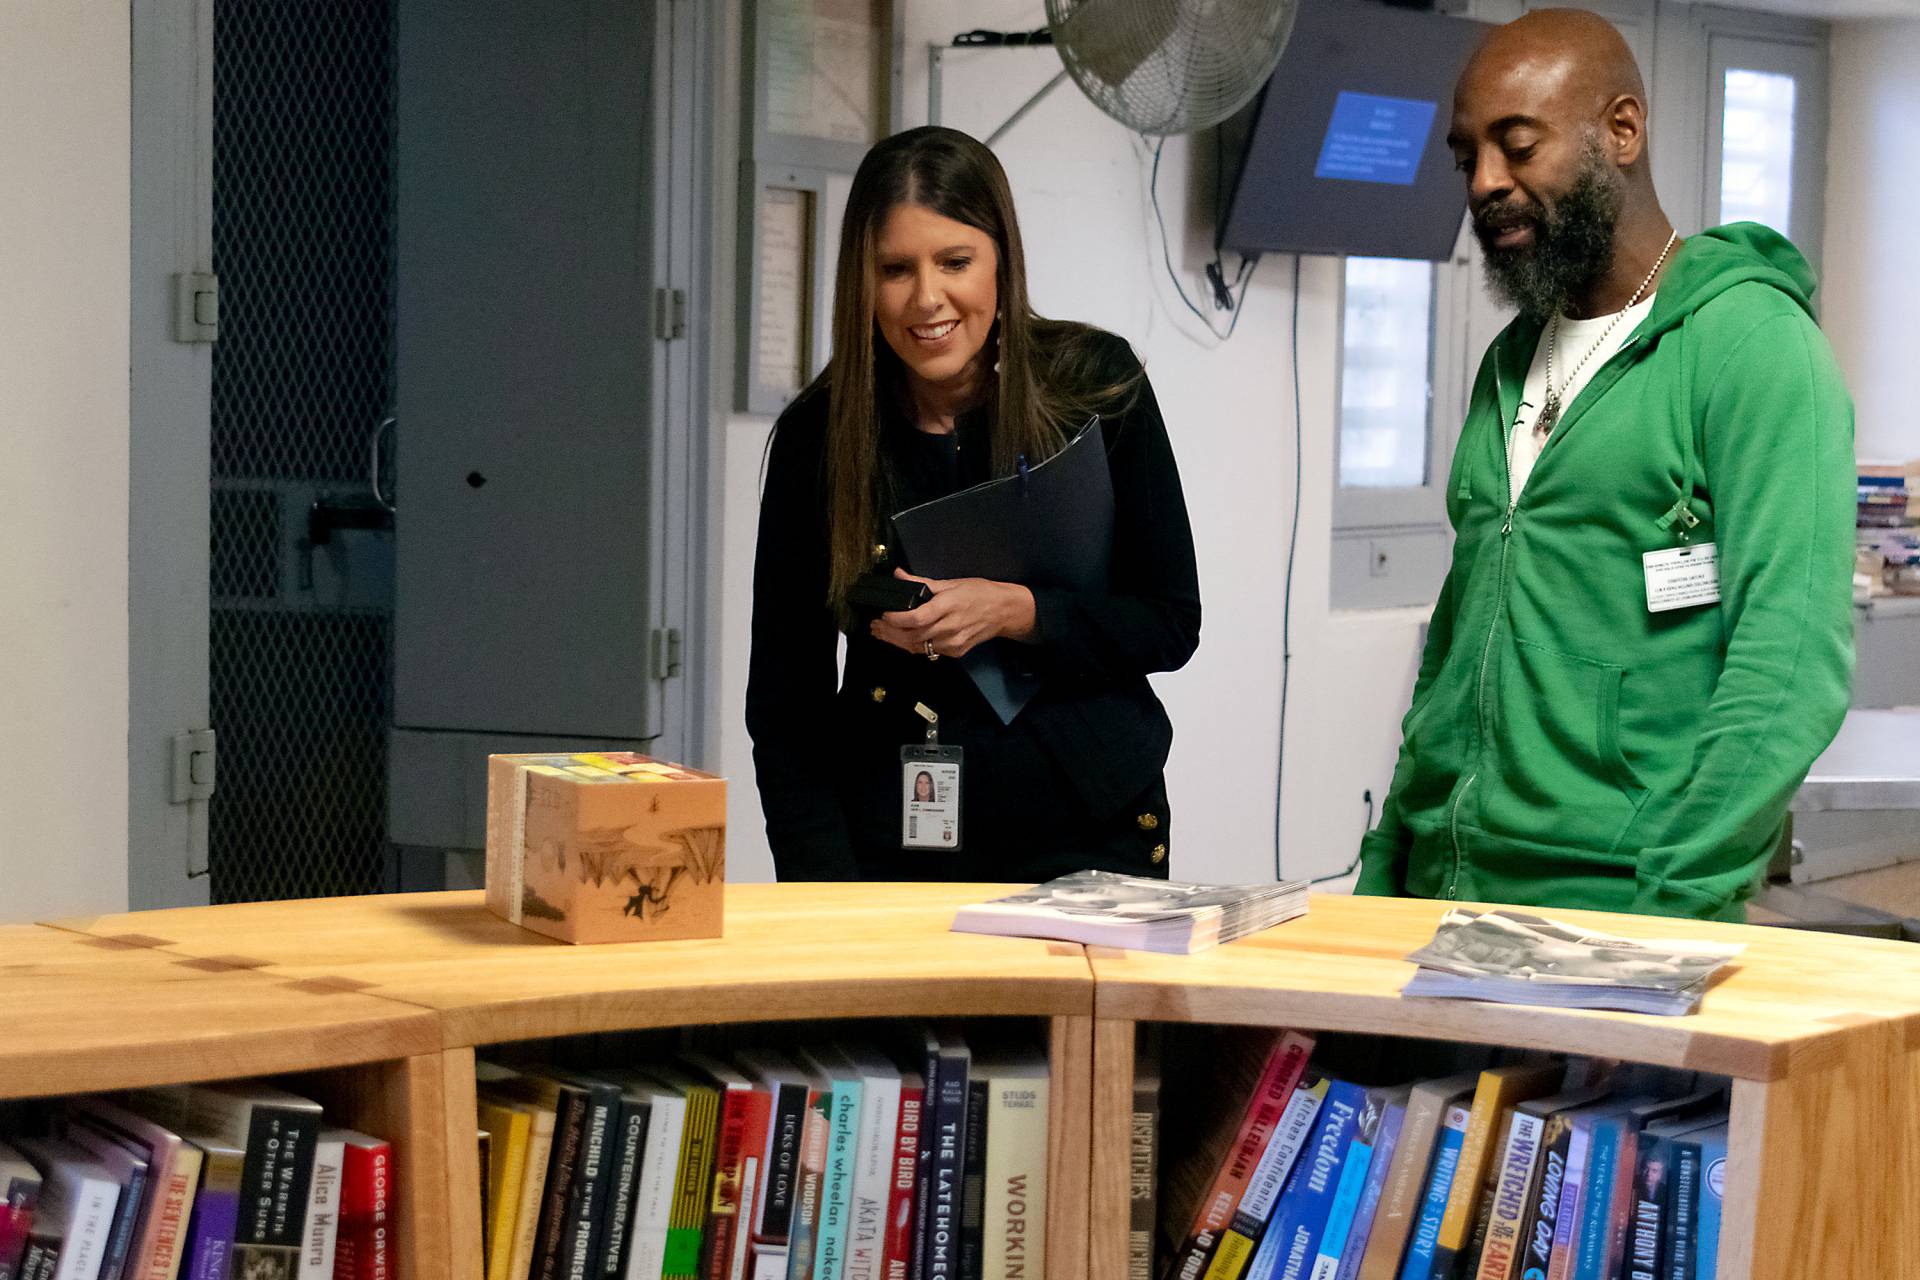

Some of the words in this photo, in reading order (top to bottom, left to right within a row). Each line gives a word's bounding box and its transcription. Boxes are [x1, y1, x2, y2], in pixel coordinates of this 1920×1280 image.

[902, 1100, 921, 1131] BIRD
[1002, 1090, 1036, 1099] STUDS
[781, 1113, 796, 1149] LICKS
[836, 1095, 855, 1152] charles
[1287, 1096, 1316, 1141] Kitchen
[1517, 1119, 1534, 1138] THE
[284, 1129, 300, 1159] THE
[585, 1106, 608, 1177] MANCHILD
[780, 1151, 791, 1166] OF
[900, 1137, 917, 1152] BY
[940, 1122, 956, 1159] THE
[1132, 1112, 1153, 1199] DISPATCHES
[1231, 1102, 1271, 1180] HALLELUJAH
[1308, 1100, 1354, 1193] Freedom
[169, 1174, 189, 1195] THE
[262, 1139, 280, 1190] OTHER
[315, 1164, 337, 1205] Alice
[897, 1157, 914, 1188] BIRD
[1252, 1145, 1294, 1217] Confidential
[1428, 1147, 1458, 1204] WRITING
[1497, 1139, 1535, 1220] WRETCHED
[1540, 1151, 1563, 1218] LOVING
[274, 1167, 294, 1234] WARMTH
[375, 1154, 386, 1222] GEORGE
[583, 1195, 592, 1216] THE
[586, 1182, 593, 1193] IN
[607, 1114, 641, 1273] COUNTERNARRATIVES
[774, 1173, 789, 1208] LOVE
[801, 1173, 817, 1225] WOODSON
[827, 1157, 848, 1226] wheelan
[1208, 1191, 1232, 1227] KELLI
[1677, 1160, 1691, 1223] CONSTELLATION
[85, 1215, 99, 1234] THE
[153, 1199, 183, 1268] SENTENCES
[255, 1197, 272, 1239] SUNS
[310, 1213, 333, 1265] Munro
[856, 1197, 880, 1242] AKATA
[1197, 1228, 1215, 1247] JO
[1413, 1215, 1438, 1258] STORY
[1632, 1200, 1660, 1268] ANTHONY
[1676, 1226, 1687, 1237] OF
[75, 1240, 92, 1272] PLACE
[1533, 1220, 1552, 1261] DAY
